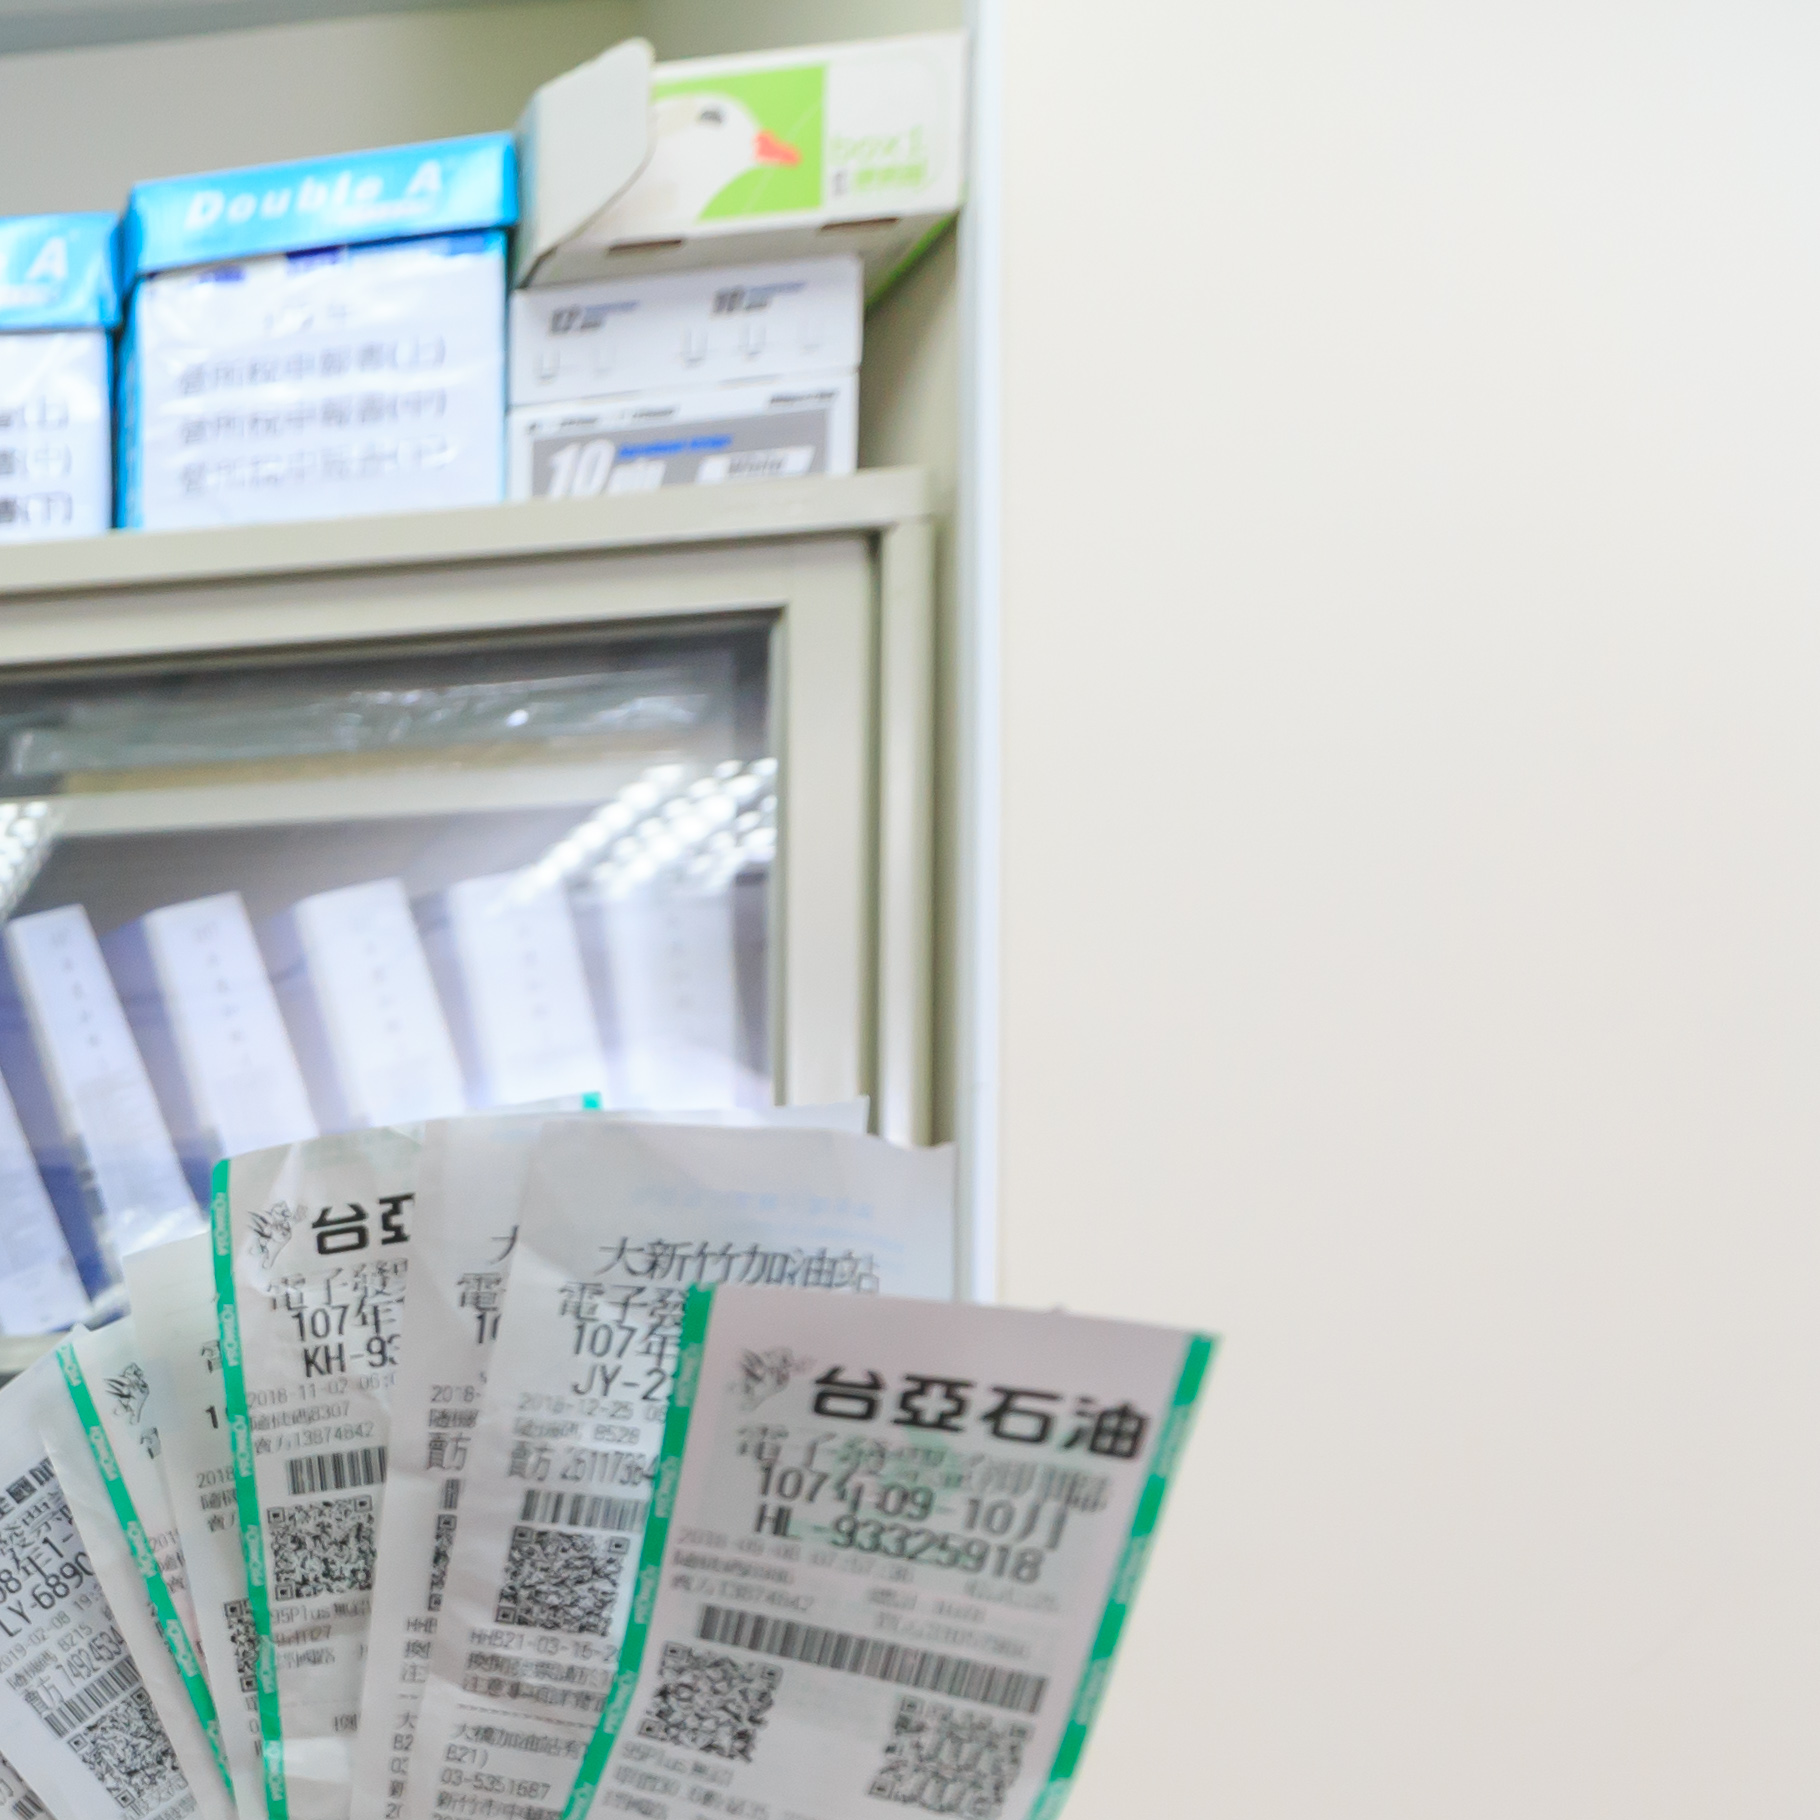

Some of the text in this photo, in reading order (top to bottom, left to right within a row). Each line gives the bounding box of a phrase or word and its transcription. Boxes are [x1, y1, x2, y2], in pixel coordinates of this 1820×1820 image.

[185, 158, 444, 229] Double A
[27, 237, 71, 282] A
[811, 1366, 1153, 1461] 台亞石油
[754, 1504, 1045, 1585] HL-93325918
